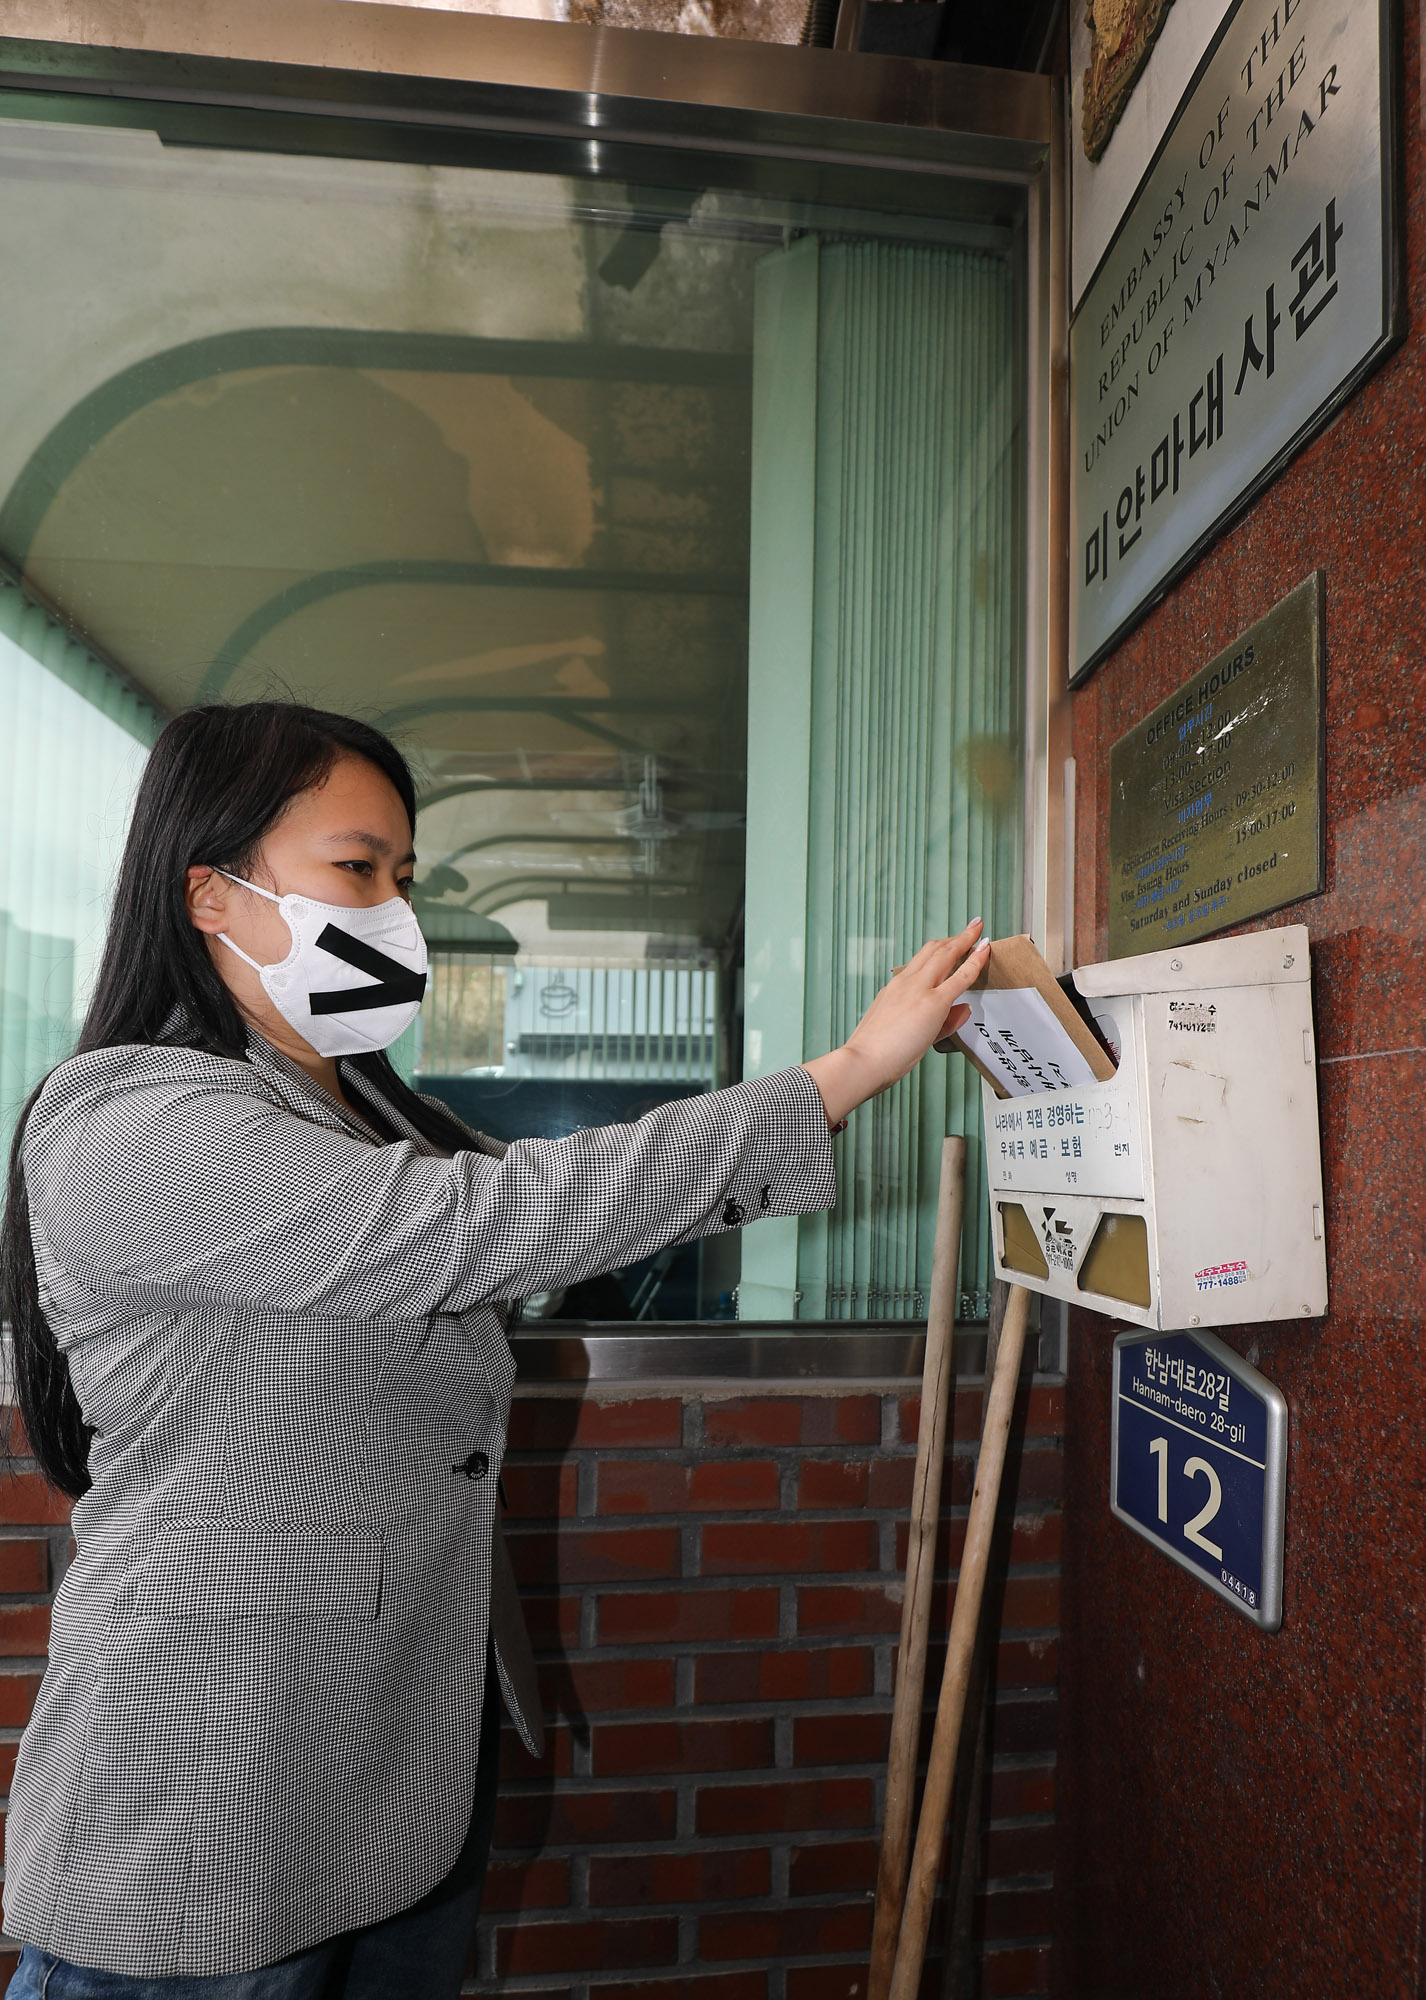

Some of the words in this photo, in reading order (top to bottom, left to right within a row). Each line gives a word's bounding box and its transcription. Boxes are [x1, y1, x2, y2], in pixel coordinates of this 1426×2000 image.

[1098, 225, 1194, 403] REPUBLIC
[1203, 154, 1235, 225] OF
[1246, 35, 1307, 156] THE
[1100, 171, 1188, 349] EMBASSY
[1199, 96, 1231, 170] OF
[1085, 374, 1140, 472] UNION
[1147, 317, 1175, 375] OF
[1183, 64, 1342, 327] MYANMAR
[1085, 197, 1344, 587] 미얀마대사관
[1146, 695, 1194, 745] OFFICE
[1198, 645, 1255, 705] HOURS
[1179, 703, 1213, 741] 업무시간
[1164, 791, 1184, 811] Visa
[1188, 760, 1232, 797] Section
[1178, 792, 1212, 823] 비자업무
[1121, 845, 1160, 875] Application
[1161, 822, 1199, 852] Receiving
[1200, 805, 1228, 828] Hours
[1121, 889, 1135, 902] Visa
[1137, 875, 1162, 896] Issuing
[1165, 861, 1190, 881] Hours
[1130, 907, 1169, 932] Saturday
[1172, 893, 1190, 912] and
[1194, 876, 1233, 902] Sunday
[1237, 852, 1277, 883] closed
[995, 1112, 1023, 1132] 나라에서
[1026, 1108, 1043, 1129] 직접
[1047, 1103, 1085, 1127] 경영하는
[1000, 1140, 1025, 1160] 우체국
[1029, 1138, 1048, 1159] 예금
[1061, 1136, 1082, 1157] 보험
[1114, 1142, 1130, 1156] 번지
[1065, 1171, 1078, 1183] 성명
[1132, 1376, 1207, 1425] Hannam-daero
[1210, 1411, 1246, 1443] 28-gil
[1145, 1347, 1231, 1413] 한남대로28길
[1149, 1436, 1223, 1562] 12
[1221, 1568, 1256, 1606] 04418
